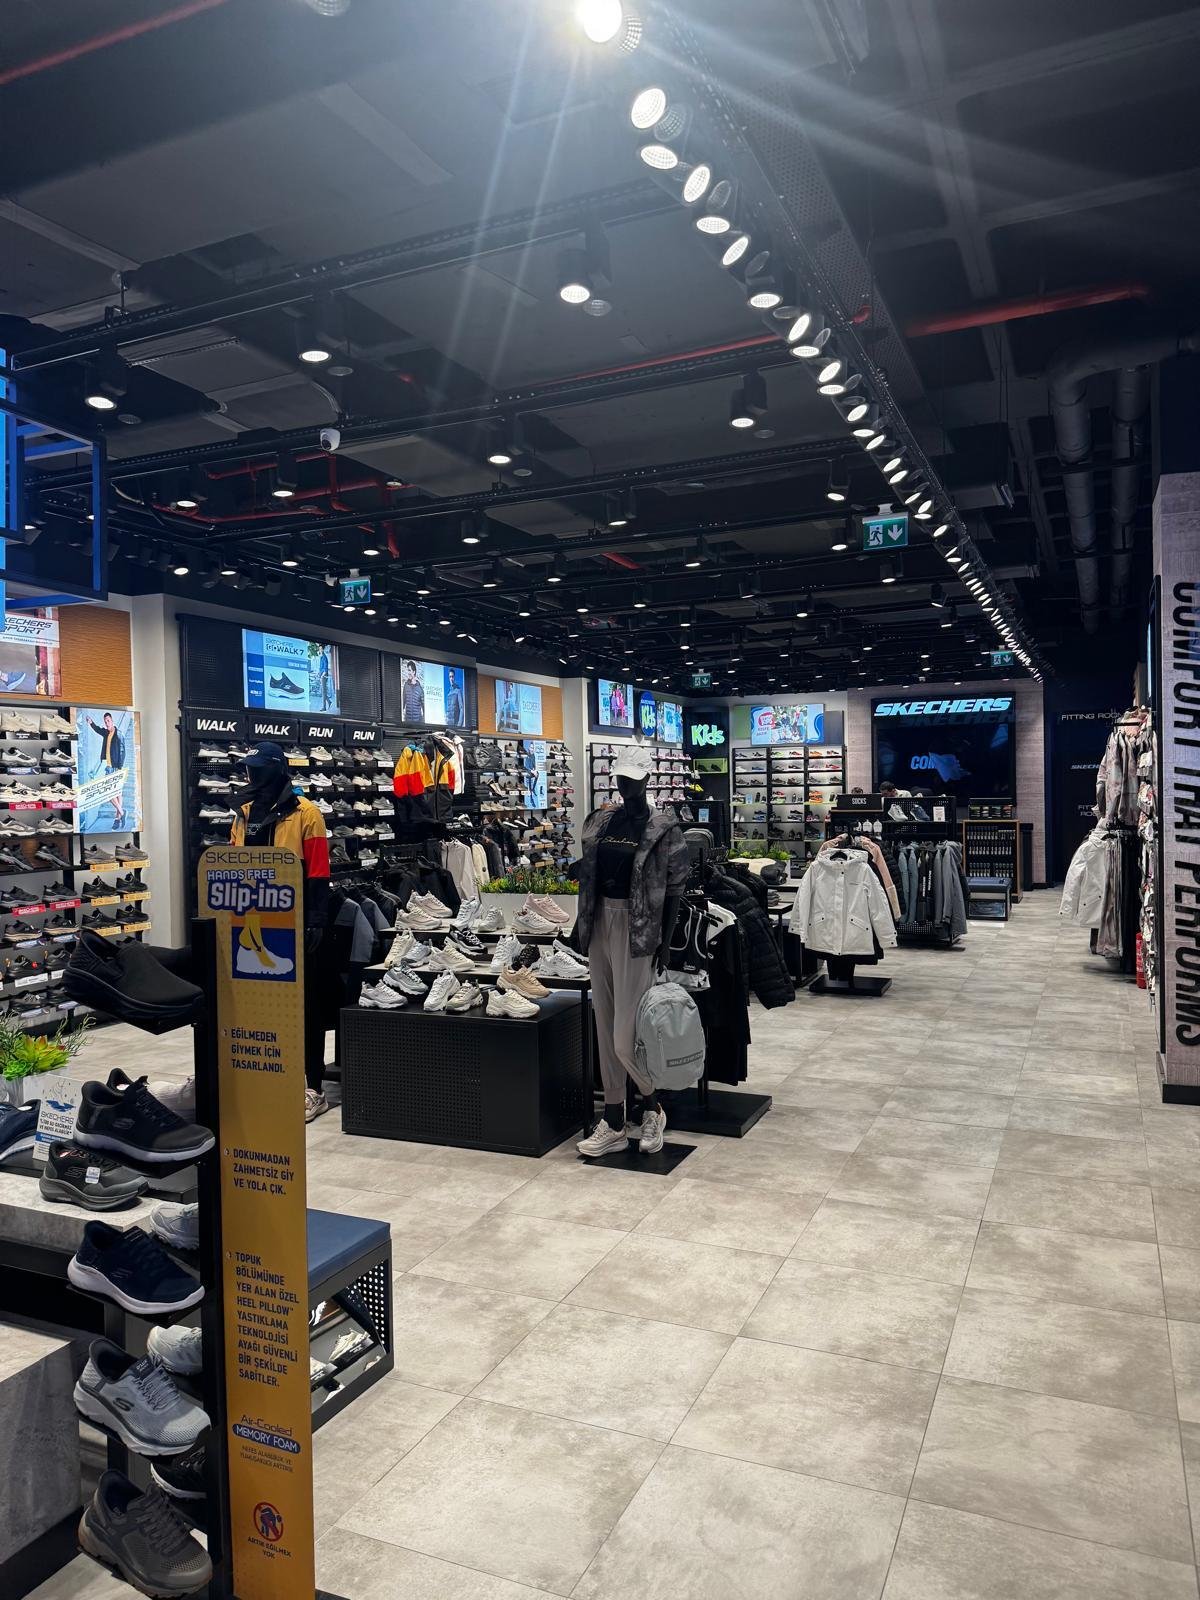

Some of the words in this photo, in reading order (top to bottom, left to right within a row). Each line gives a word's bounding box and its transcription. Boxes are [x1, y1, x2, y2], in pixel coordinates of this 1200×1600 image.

[4, 617, 52, 629] ECHERS
[873, 697, 1013, 717] SKECHERS
[1061, 713, 1095, 721] FITTING
[196, 719, 237, 732] WALK
[254, 723, 290, 736] WALK
[308, 727, 334, 738] RUN
[353, 730, 375, 741] RUN
[690, 723, 725, 747] Kids
[206, 852, 296, 866] SKECHERS
[207, 869, 245, 881] HANDS
[247, 869, 276, 880] FREE
[209, 880, 294, 912] Slip-ins
[231, 1028, 277, 1043] EĞİLMEDEN
[231, 1044, 262, 1057] GİYMEK
[264, 1044, 281, 1058] İÇİN
[231, 1058, 286, 1073] TASARLANDI.
[40, 1111, 74, 1125] SKECHERS
[233, 1149, 291, 1166] DOKUNMADAN
[233, 1163, 279, 1179] ZAHMETSİZ
[280, 1168, 294, 1181] GİY
[234, 1178, 244, 1188] VE
[246, 1179, 267, 1193] YOLA
[235, 1252, 262, 1266] TOPUK
[235, 1265, 285, 1286] BÖLÜMÜNDE
[236, 1281, 252, 1293] YER
[254, 1286, 276, 1299] ALAN
[279, 1288, 299, 1303] ÖZEL
[236, 1296, 257, 1309] HEEL
[237, 1310, 289, 1331] YASTIKLAMA
[237, 1324, 289, 1346] TEKNOLOJİSİ
[238, 1338, 261, 1353] AYAĞI
[263, 1343, 298, 1363] GÜVENLİ
[238, 1353, 252, 1366] BİR
[254, 1357, 288, 1375] ŞEKİLDE
[240, 1413, 293, 1437] Air-Cooled
[235, 1424, 271, 1444] MEMORY
[273, 1437, 299, 1453] FOAM
